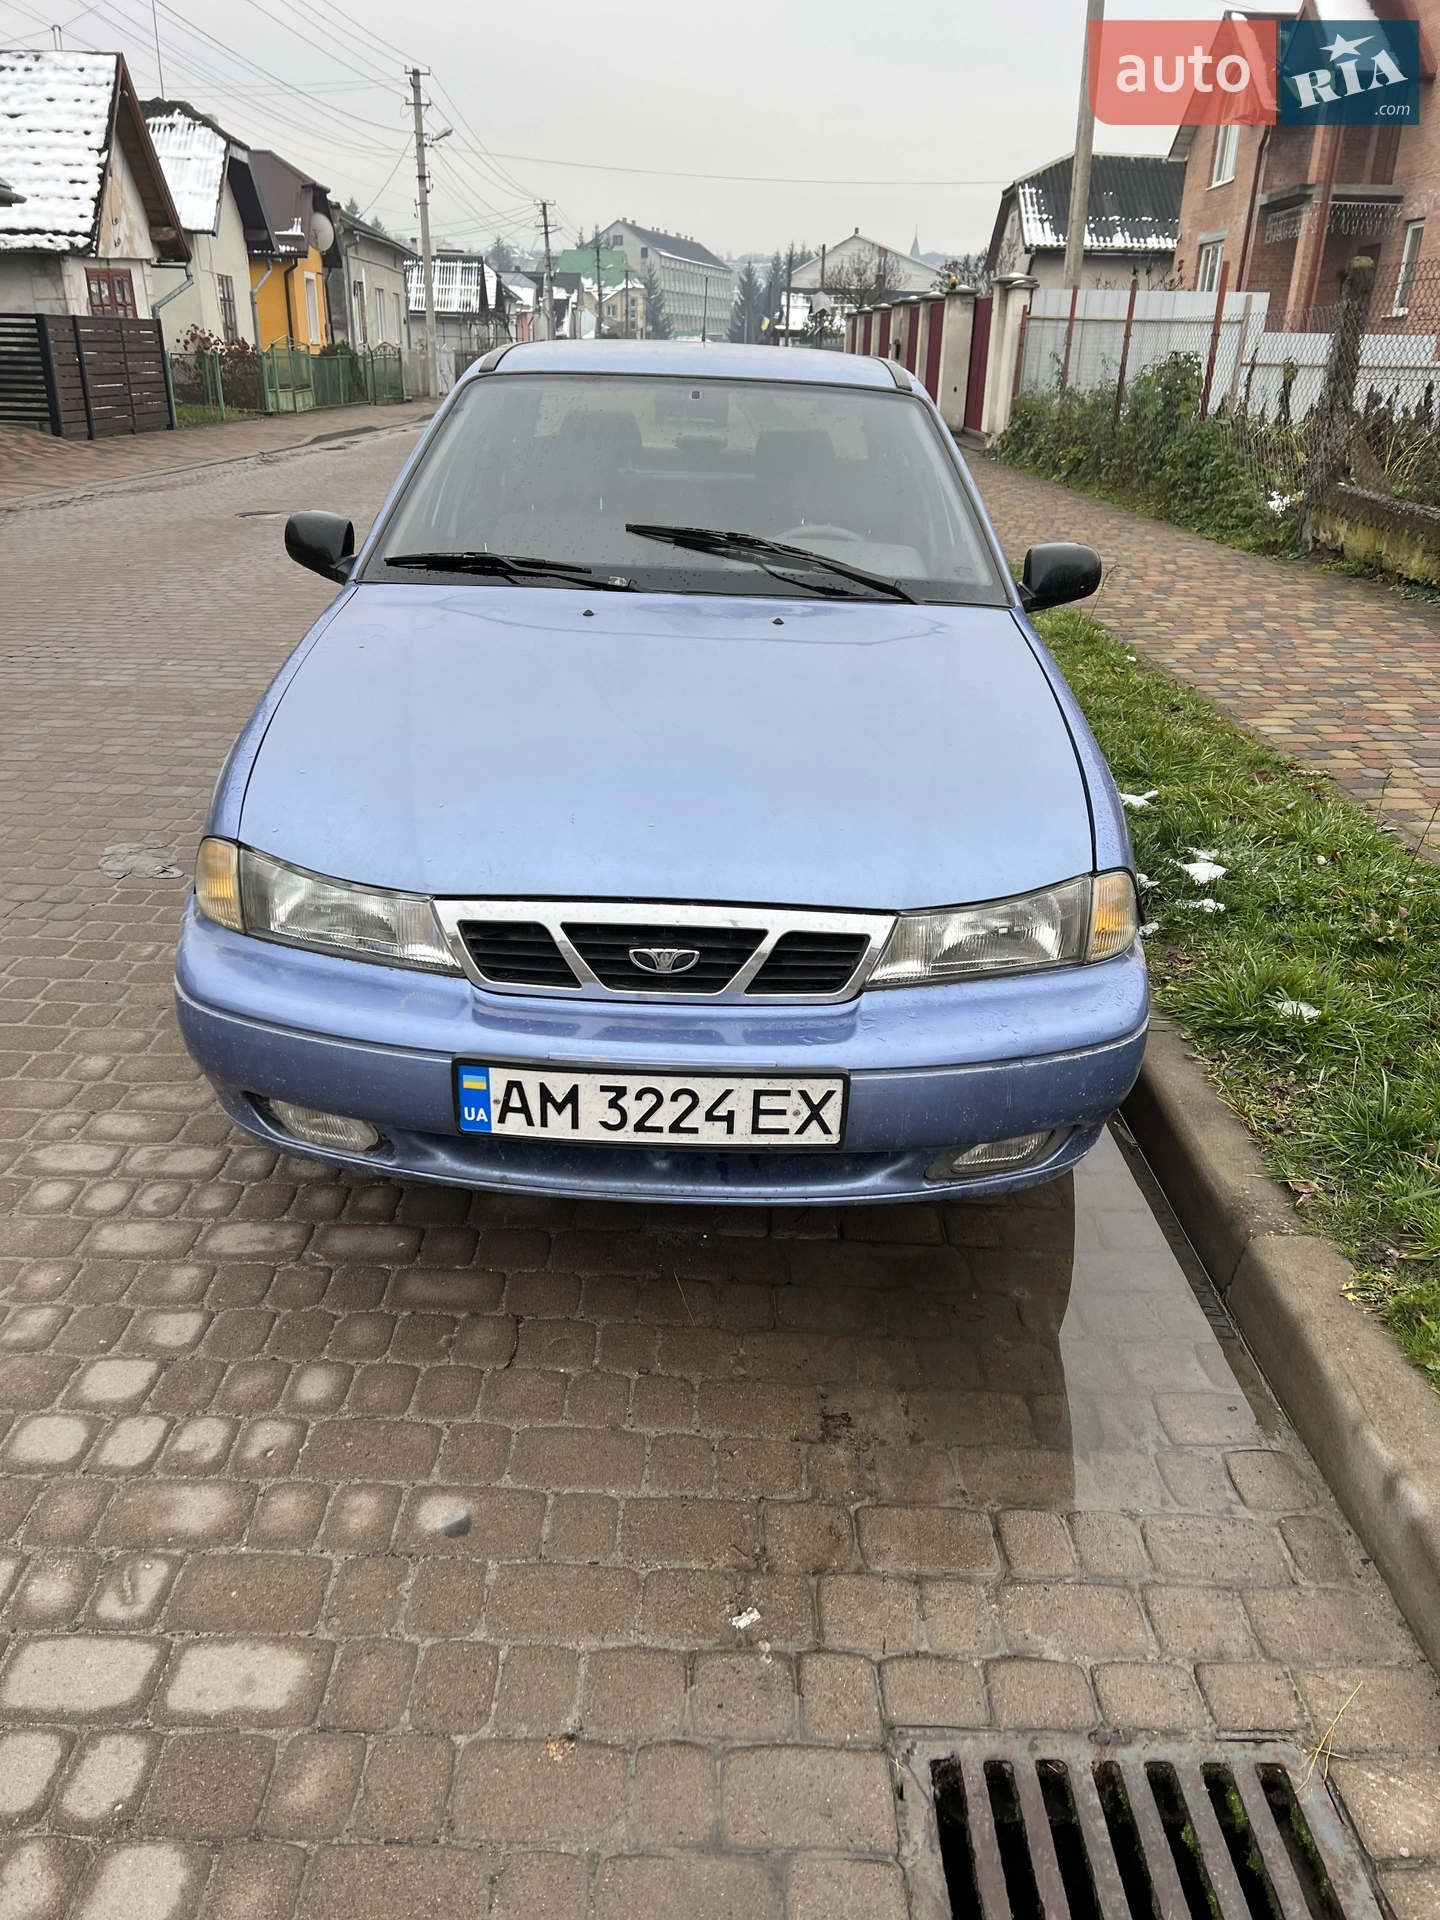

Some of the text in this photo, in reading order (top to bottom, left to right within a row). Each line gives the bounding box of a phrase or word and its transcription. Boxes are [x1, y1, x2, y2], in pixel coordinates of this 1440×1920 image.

[464, 1106, 489, 1123] UA
[497, 1080, 836, 1135] AM 3224 EX
